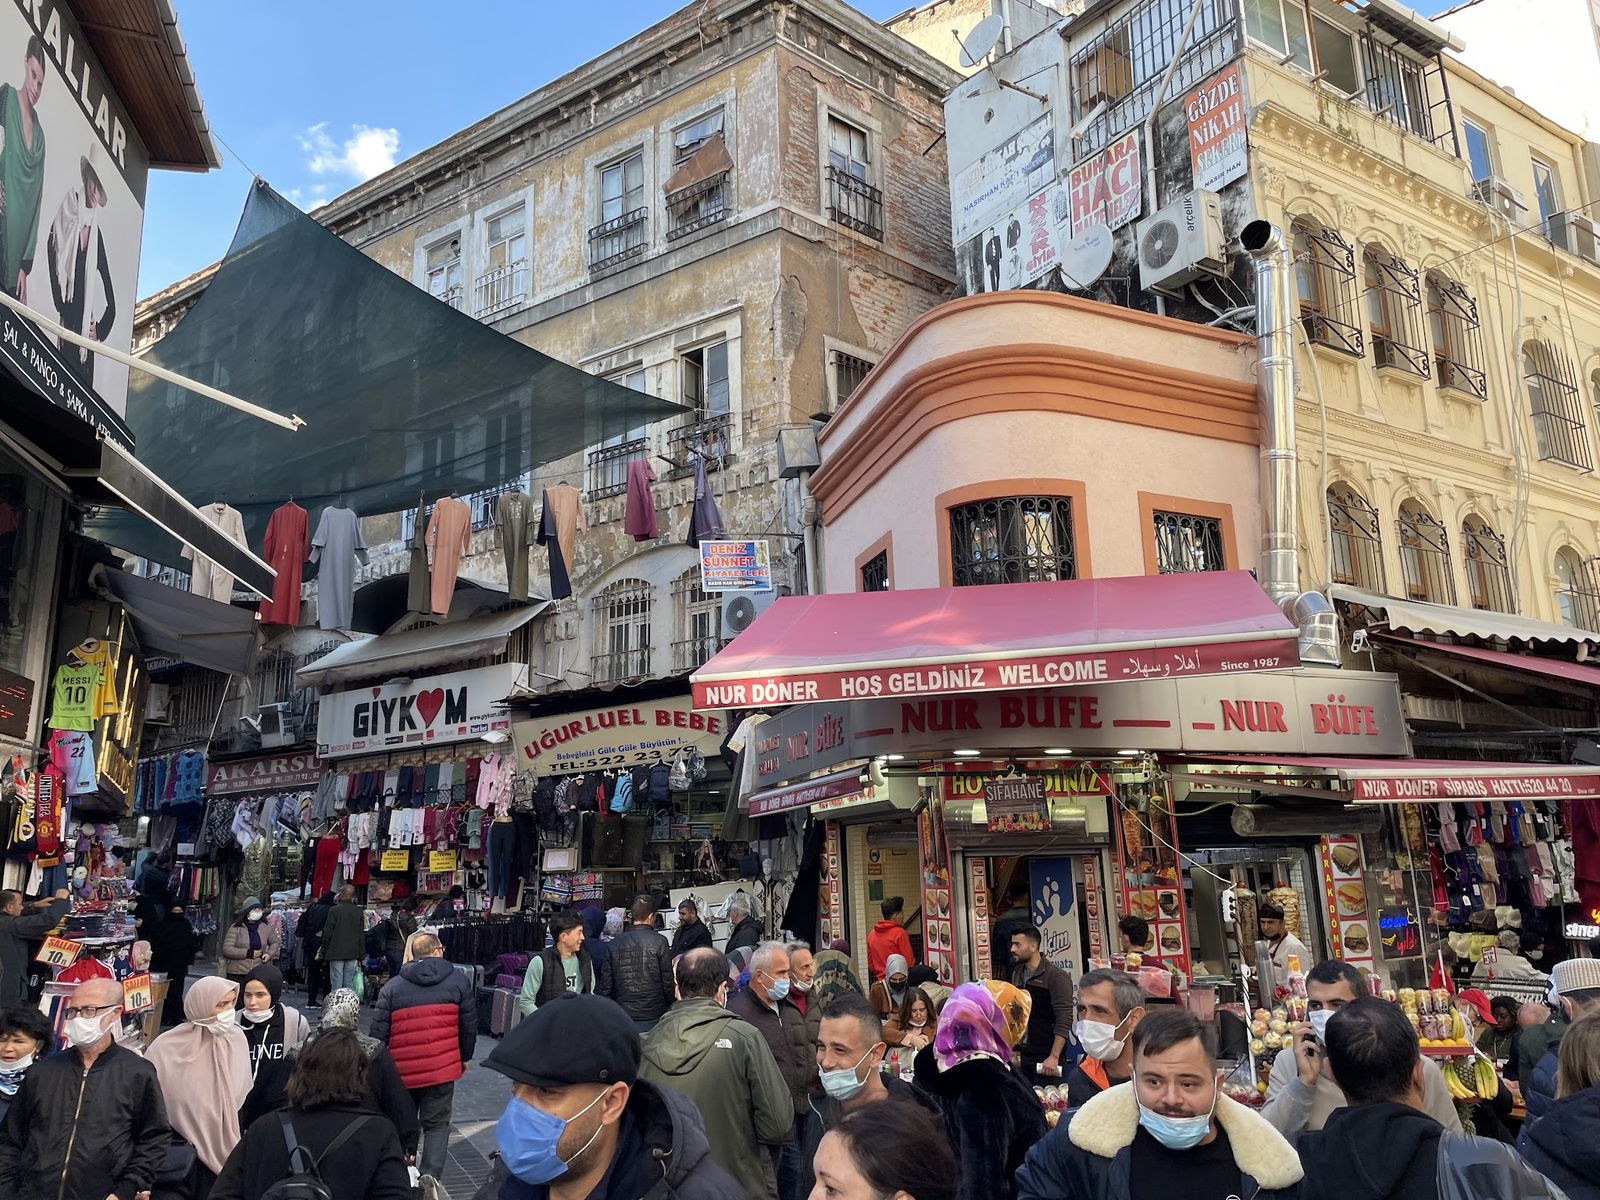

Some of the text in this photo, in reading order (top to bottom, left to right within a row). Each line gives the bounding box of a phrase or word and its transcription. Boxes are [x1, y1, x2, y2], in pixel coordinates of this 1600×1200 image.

[1188, 73, 1239, 123] GÖZDE
[1193, 101, 1241, 149] NİKAH
[1072, 135, 1137, 190] BUHARA
[1226, 161, 1241, 173] HAN
[1072, 151, 1139, 223] HACI
[1183, 197, 1195, 231] arçelik
[4, 320, 19, 350] ŞAL
[22, 342, 28, 358] &
[30, 347, 58, 388] PANÇO
[703, 555, 754, 567] SÜNNET
[710, 544, 747, 554] DENİZ
[704, 569, 768, 577] KIYAFETLERİ
[1220, 657, 1280, 670] Since 1987
[62, 676, 91, 685] MESSI
[705, 658, 1108, 705] NUR DÖNER HOŞ GELDİNİZ WELCOME
[65, 686, 86, 705] 10
[902, 688, 1103, 733] NUR BÜFE
[1221, 693, 1380, 735] NUR BÜFE
[524, 709, 721, 760] UĞURLUEL BEBE
[786, 729, 809, 761] NUR
[816, 711, 845, 752] BÜFE
[71, 746, 86, 758] 22
[556, 749, 595, 760] Bebeğinizi
[598, 746, 616, 755] Güle
[618, 743, 638, 753] Güle
[640, 738, 677, 750] Büyütün
[634, 750, 661, 761] 23
[212, 754, 323, 782] AKARSU
[39, 774, 53, 803] UNITED
[1362, 780, 1390, 798] NUR
[1443, 776, 1488, 798] SİPARİŞ
[1546, 777, 1559, 793] 44
[1559, 777, 1572, 793] 20
[47, 950, 63, 963] 10
[130, 992, 142, 1008] 10
